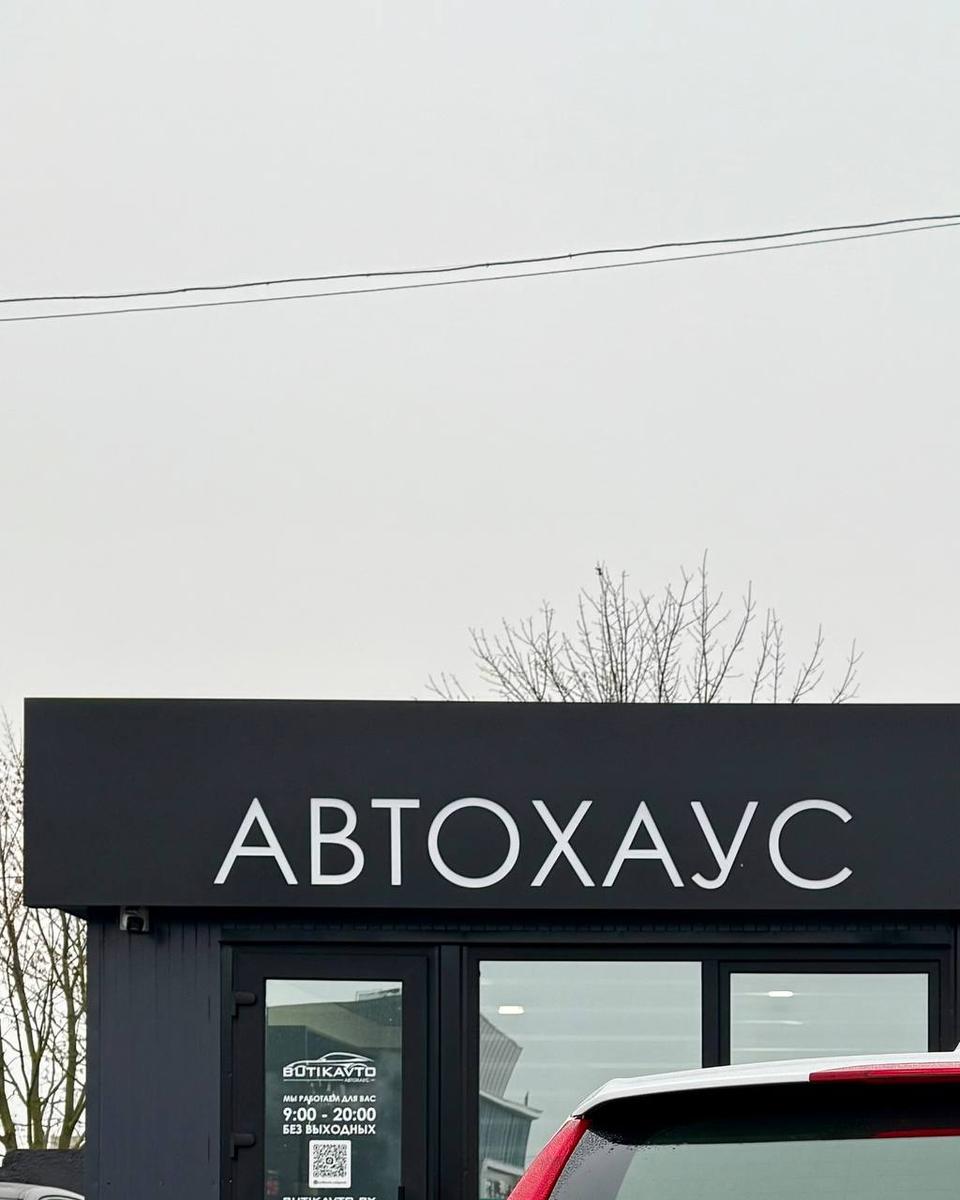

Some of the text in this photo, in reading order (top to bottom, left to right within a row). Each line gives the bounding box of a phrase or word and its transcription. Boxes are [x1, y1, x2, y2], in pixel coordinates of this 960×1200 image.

[213, 798, 853, 889] АВТОХАУС
[282, 1066, 377, 1077] BUTIKAVTO
[299, 1095, 340, 1103] РАБОТАЕМ
[341, 1095, 358, 1103] ДЛЯ
[283, 1107, 317, 1122] 9:00
[333, 1107, 377, 1122] 20:00
[282, 1124, 376, 1136] БЕЗ ВЫХОДНЫХ
